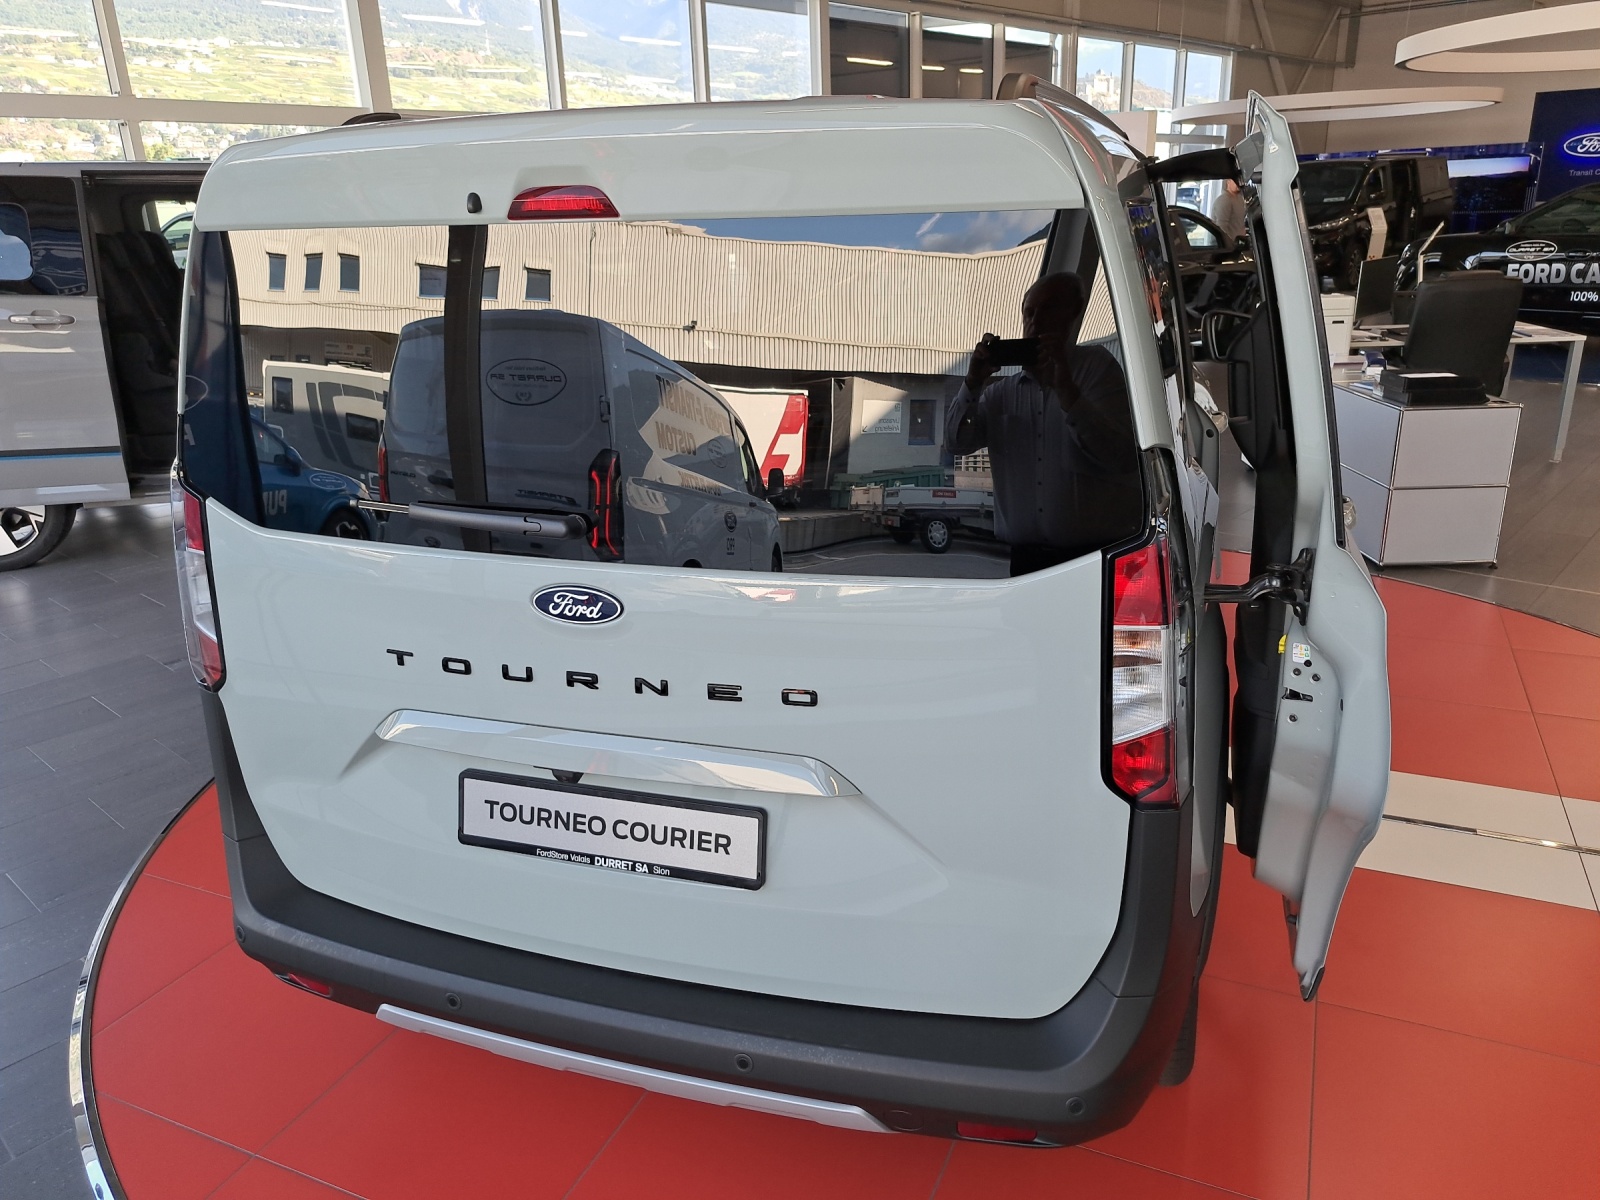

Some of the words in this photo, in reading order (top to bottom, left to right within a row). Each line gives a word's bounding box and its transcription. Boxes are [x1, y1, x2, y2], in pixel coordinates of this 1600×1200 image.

[1506, 263, 1566, 284] FORD
[1570, 291, 1599, 302] 100%
[386, 648, 819, 708] TOURNEO
[484, 799, 606, 837] TOURNEO
[612, 819, 732, 856] COURIER
[536, 848, 569, 861] FordStore
[569, 852, 591, 864] Valais
[594, 856, 633, 872] DURRET
[634, 863, 649, 874] SA
[653, 865, 670, 876] Sion
